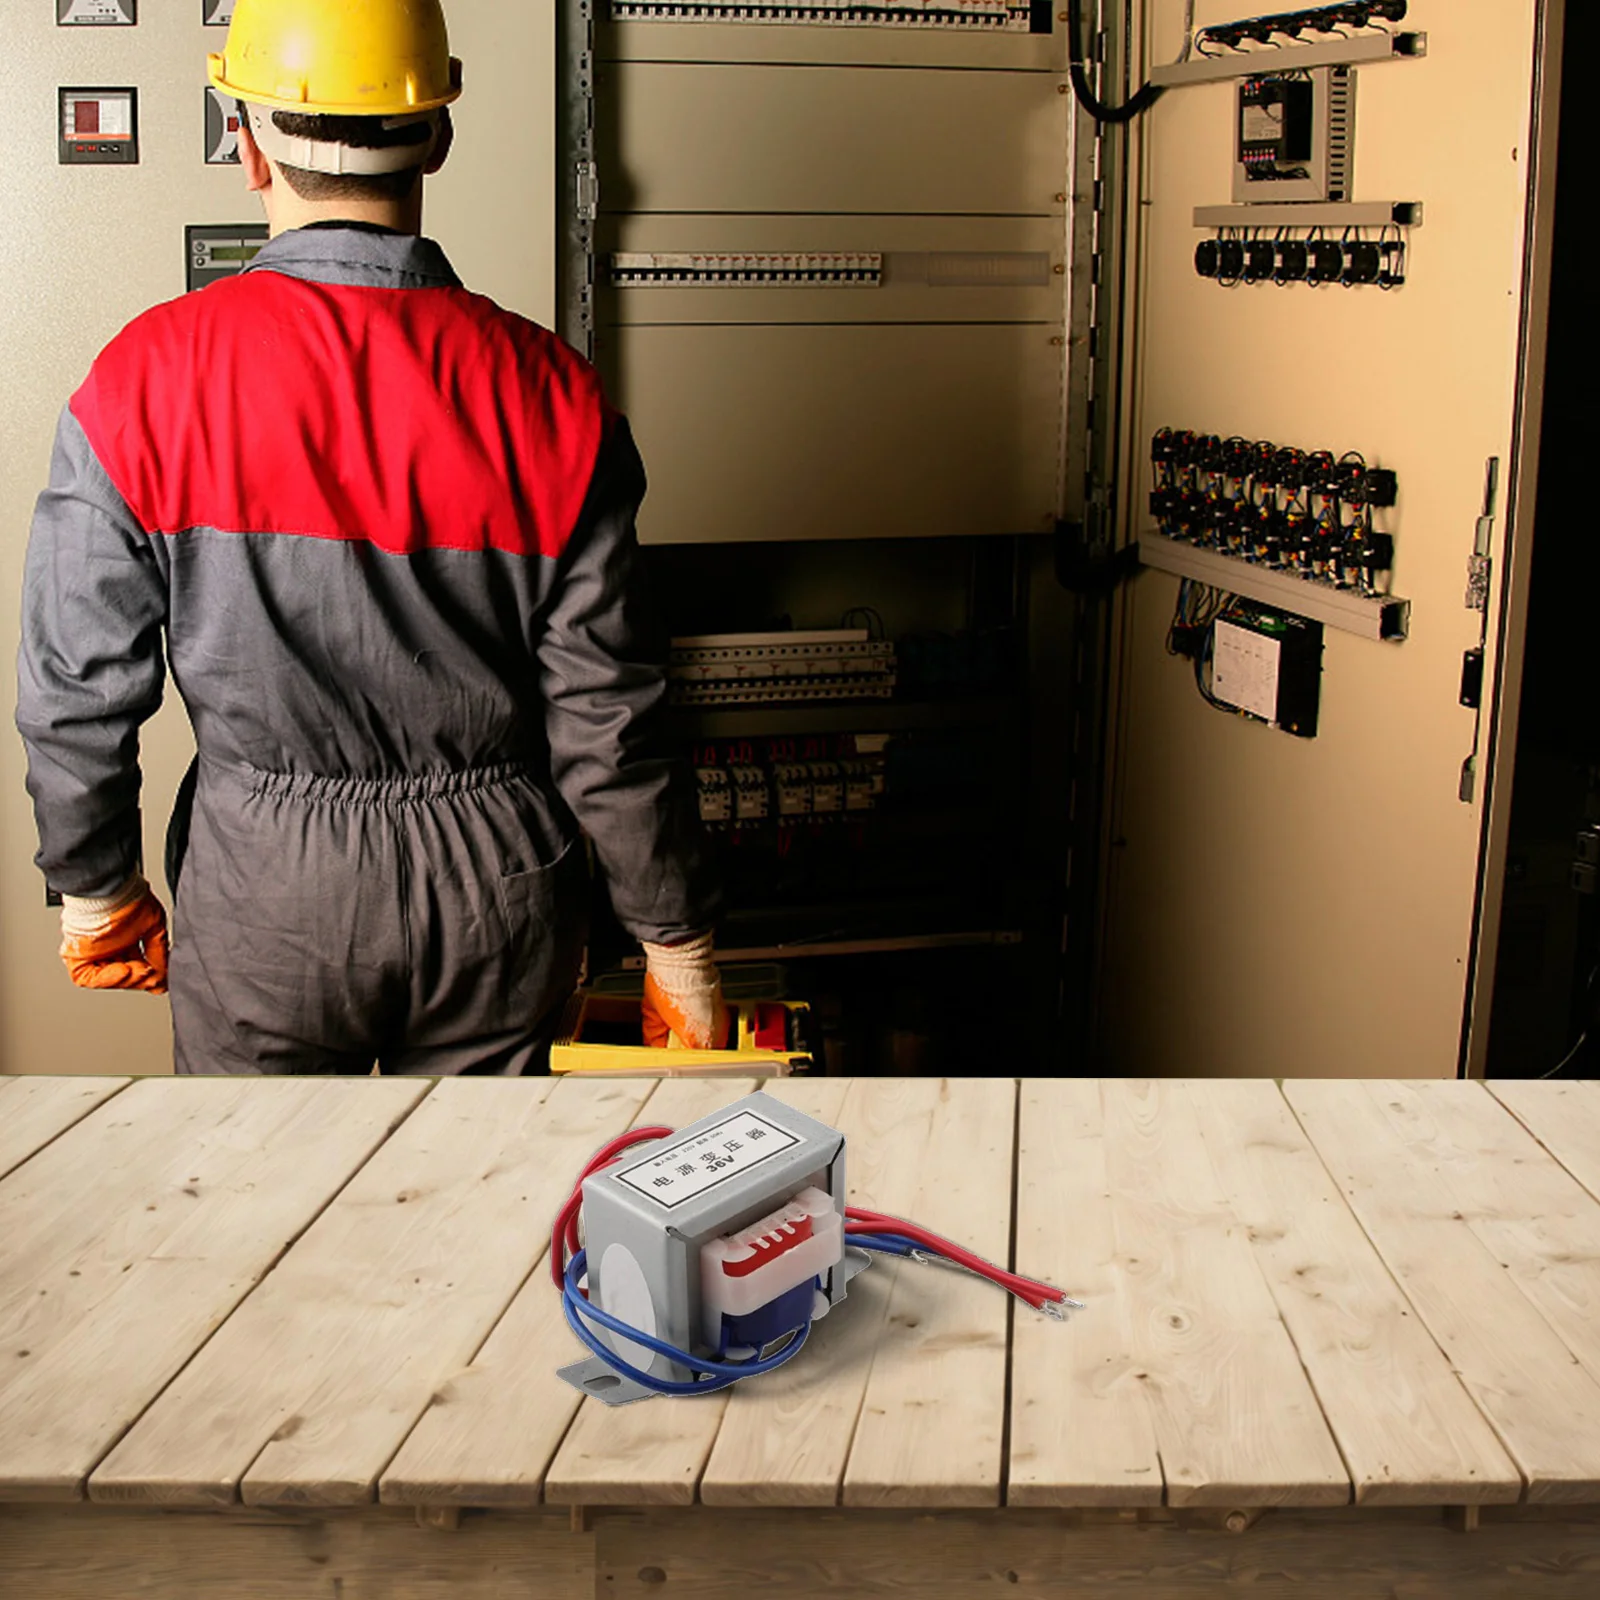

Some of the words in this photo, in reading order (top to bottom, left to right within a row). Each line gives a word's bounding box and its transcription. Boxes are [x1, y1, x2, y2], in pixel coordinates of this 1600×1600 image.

[652, 1128, 767, 1187] 电源变压器
[706, 1155, 735, 1172] 36V
